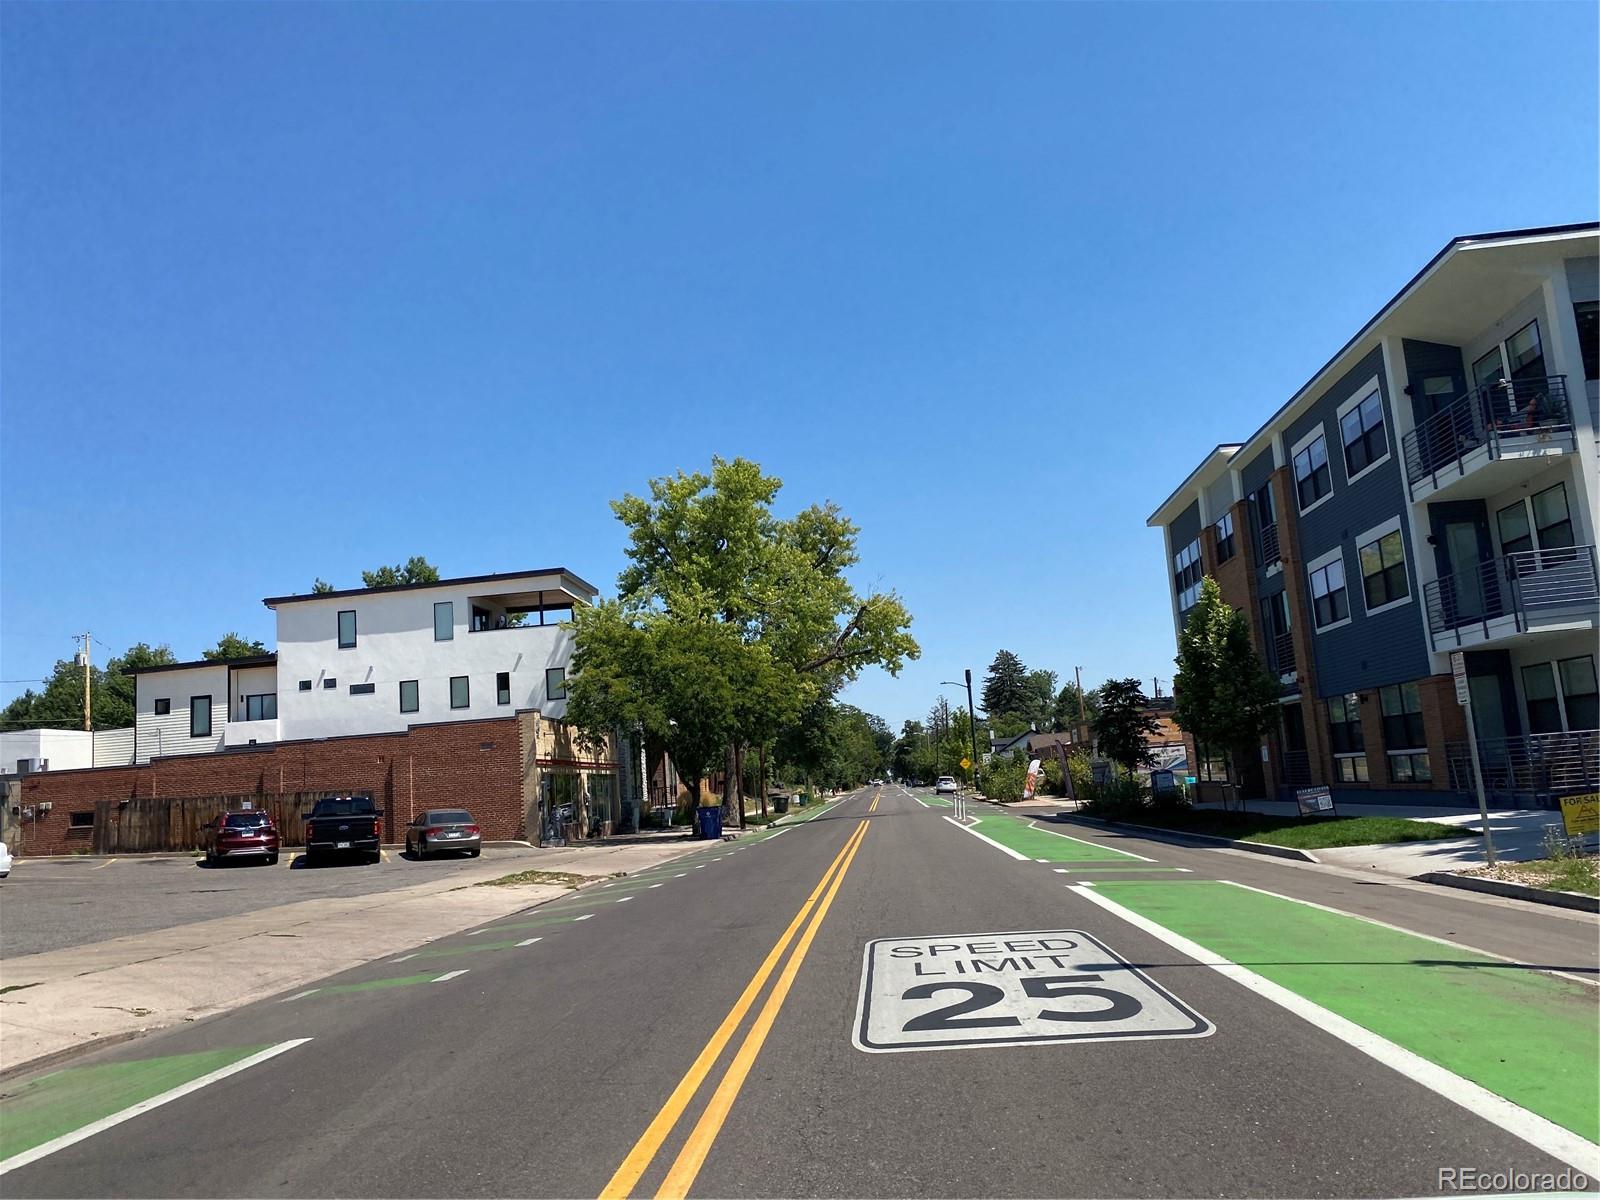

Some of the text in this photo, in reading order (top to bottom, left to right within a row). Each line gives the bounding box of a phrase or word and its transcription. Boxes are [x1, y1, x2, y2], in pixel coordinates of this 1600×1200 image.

[1564, 797, 1582, 806] FOR
[890, 939, 1078, 958] SPEED
[915, 954, 1069, 976] LIMIT
[901, 974, 1143, 1032] 25
